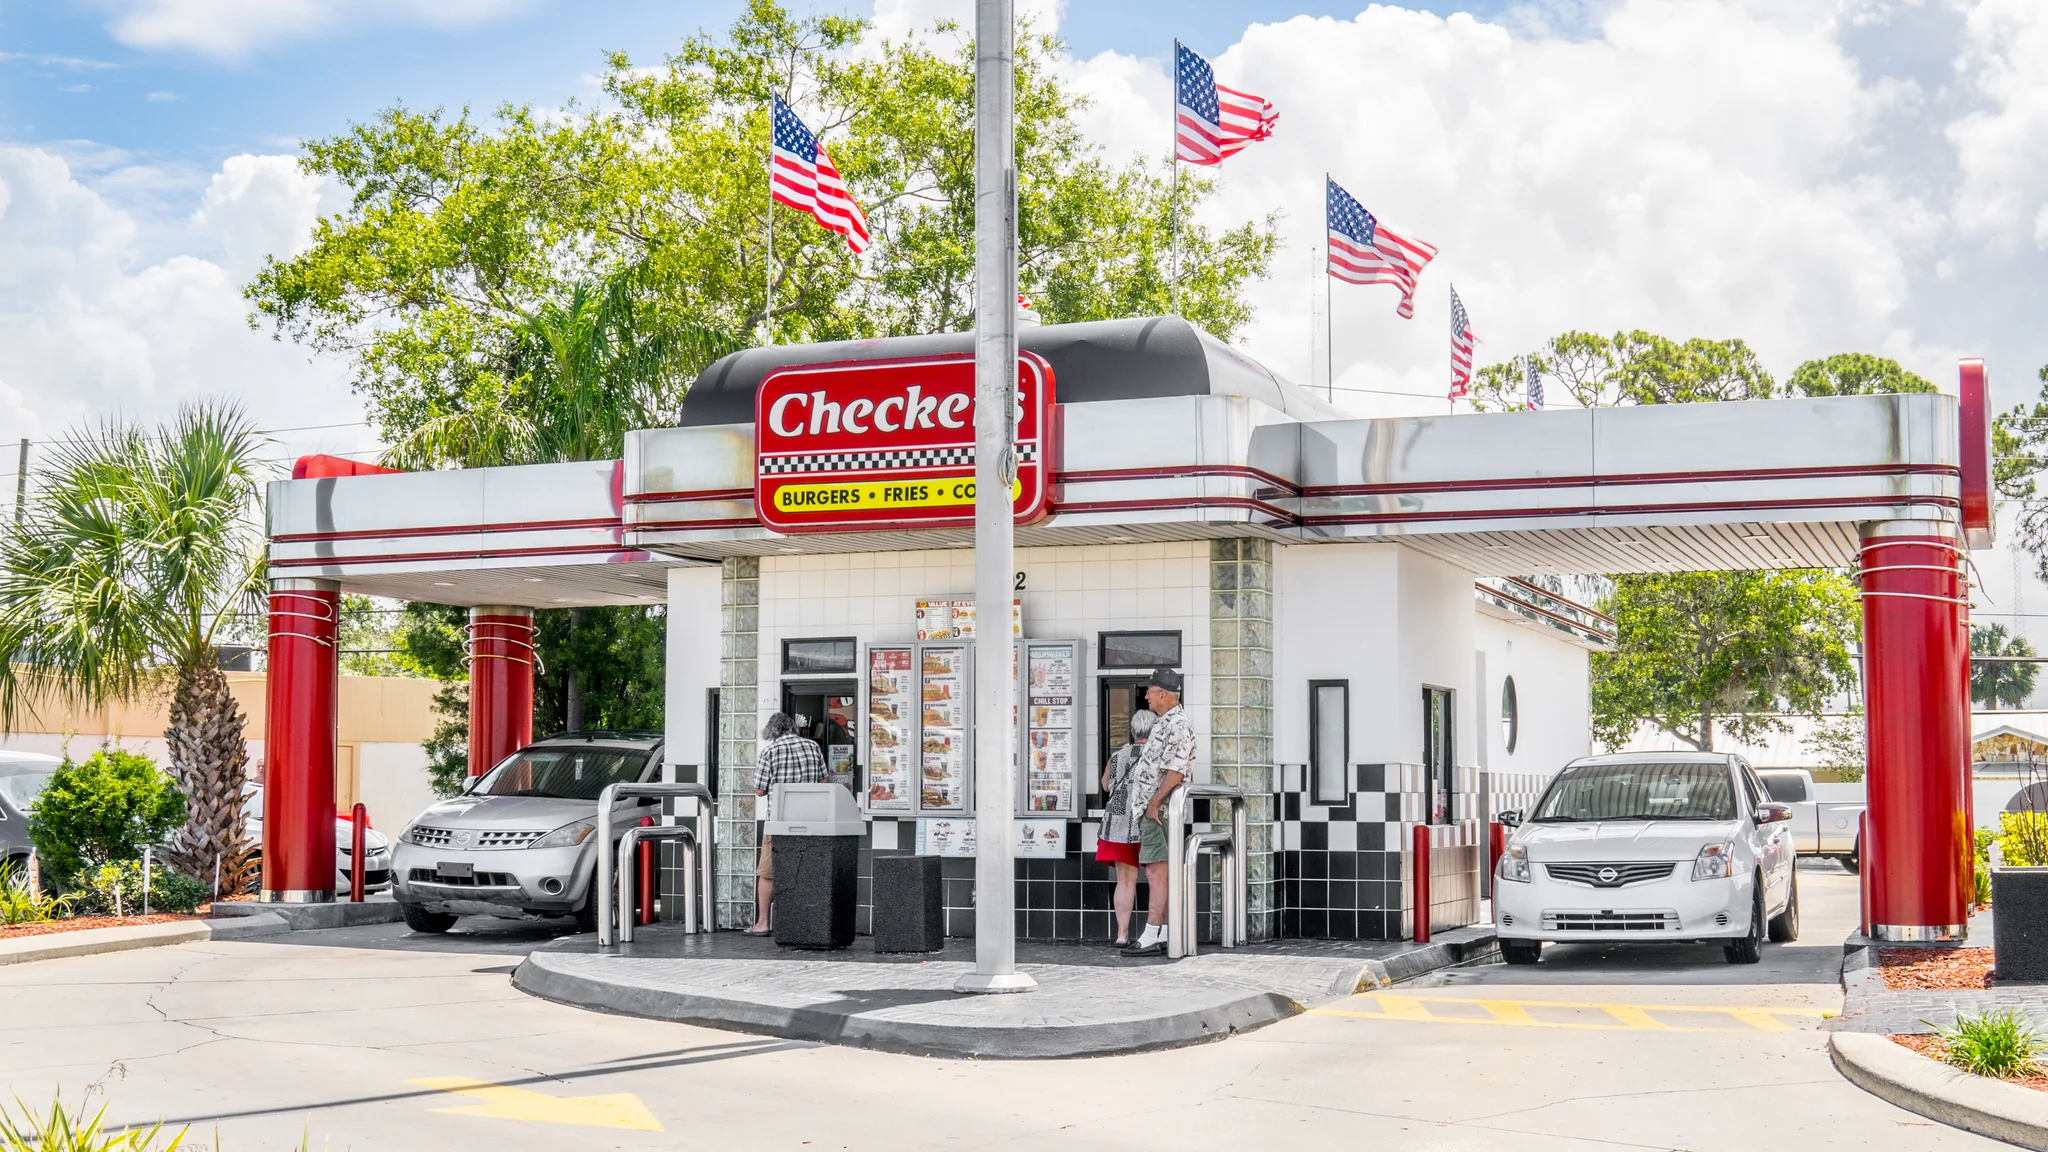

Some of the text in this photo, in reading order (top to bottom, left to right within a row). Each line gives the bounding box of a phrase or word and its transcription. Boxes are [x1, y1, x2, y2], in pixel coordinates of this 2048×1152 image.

[768, 384, 1026, 437] Checke
[782, 488, 861, 507] BURGERS
[884, 485, 928, 502] FRIES
[1013, 571, 1026, 591] 2
[876, 652, 885, 660] GO
[1029, 650, 1071, 659] MILKSHAKES
[1033, 697, 1052, 705] CHILL
